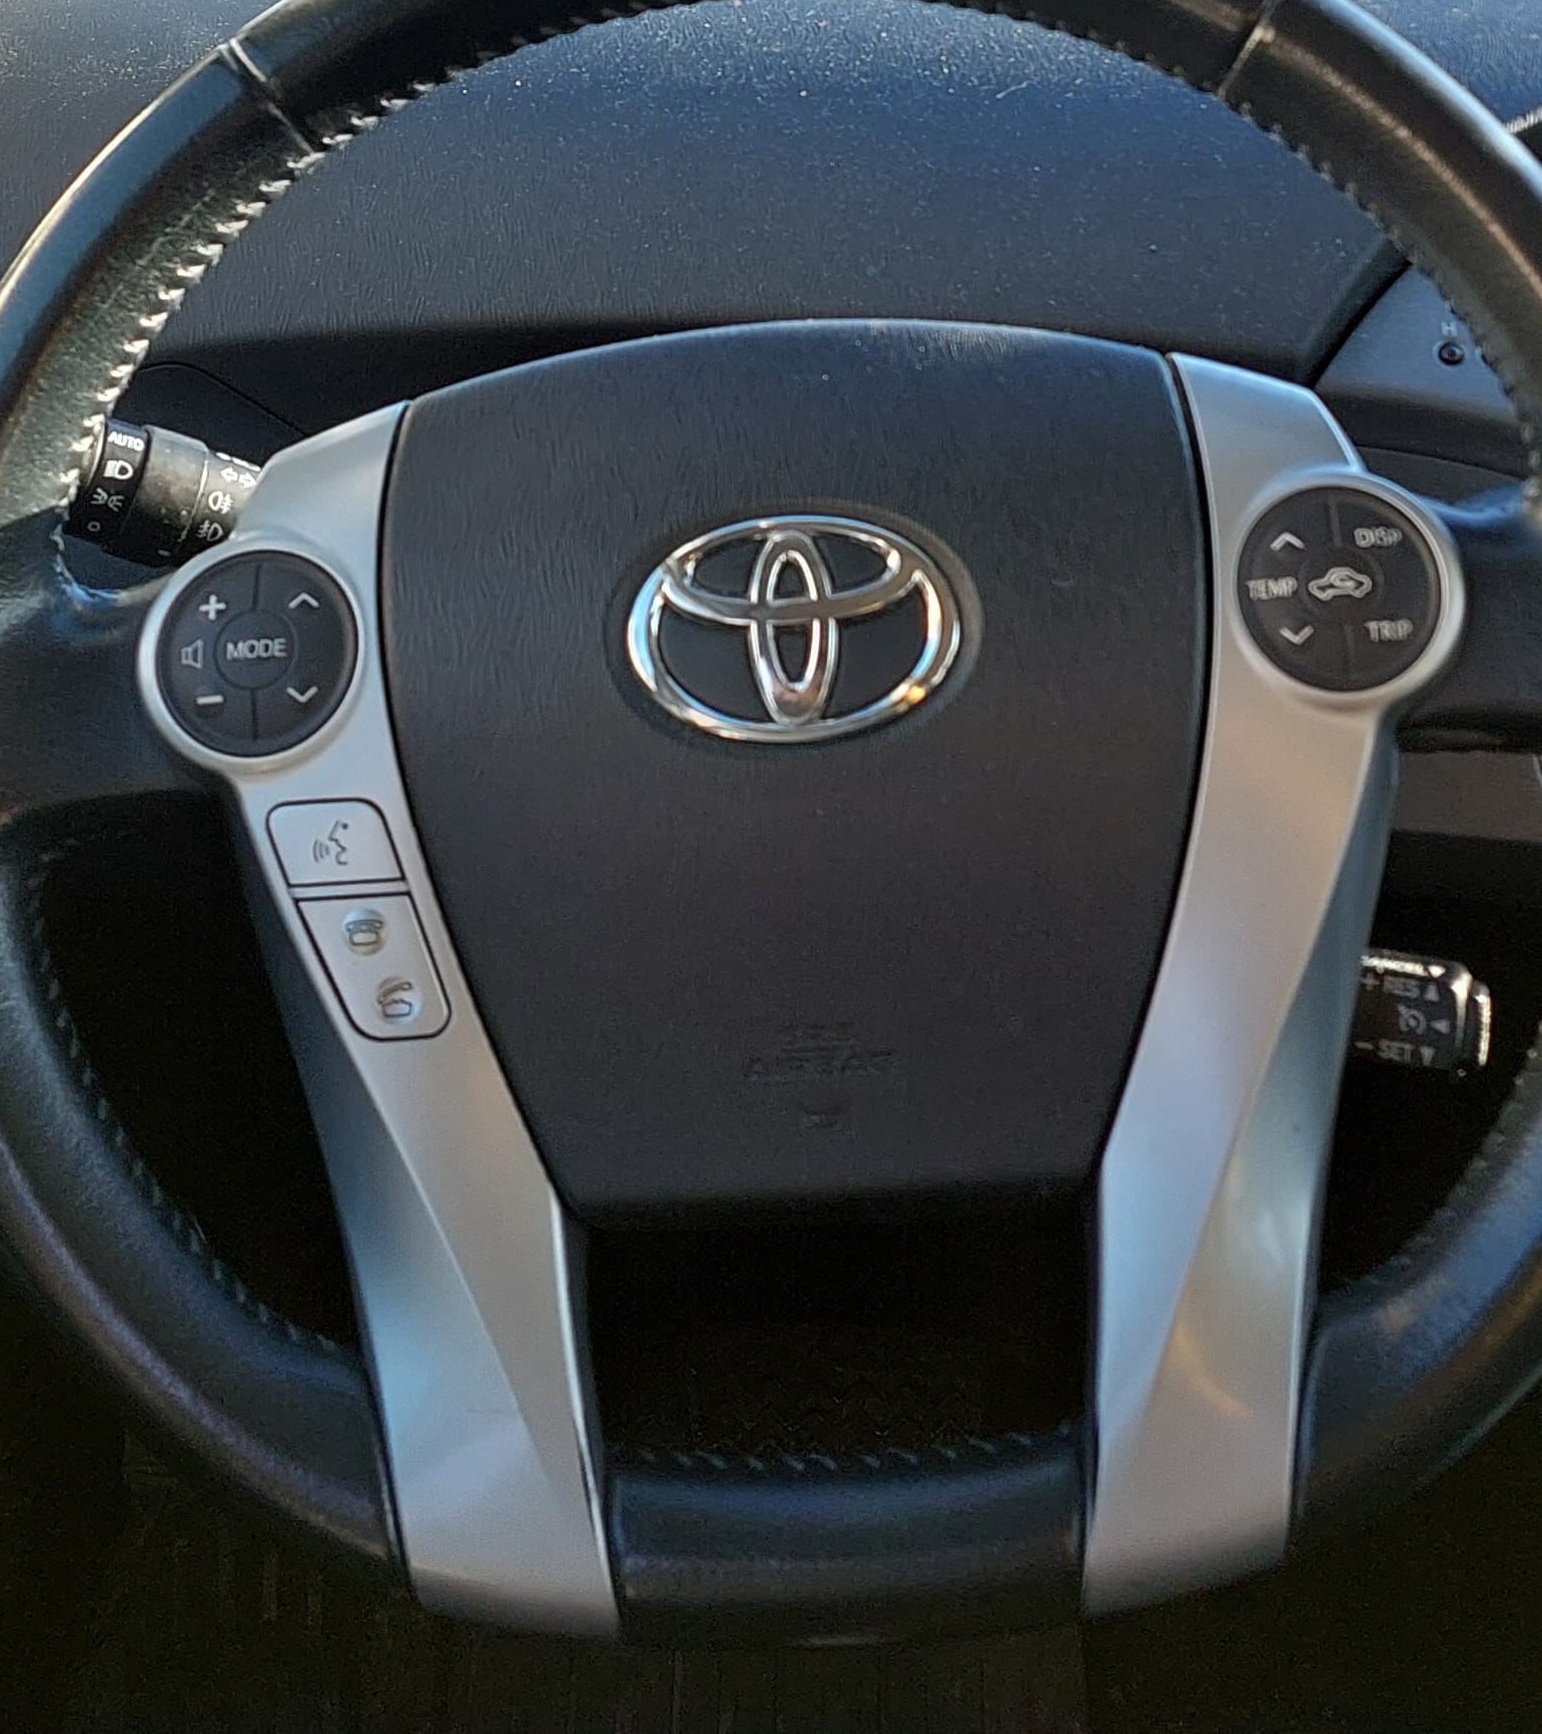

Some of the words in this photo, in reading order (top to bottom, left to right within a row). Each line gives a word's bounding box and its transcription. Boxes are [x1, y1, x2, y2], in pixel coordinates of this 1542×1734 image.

[108, 431, 145, 452] AUTO
[1354, 526, 1402, 548] DISP
[1245, 576, 1298, 600] TEMP
[1364, 619, 1413, 642] TRIP
[225, 637, 288, 660] MODE
